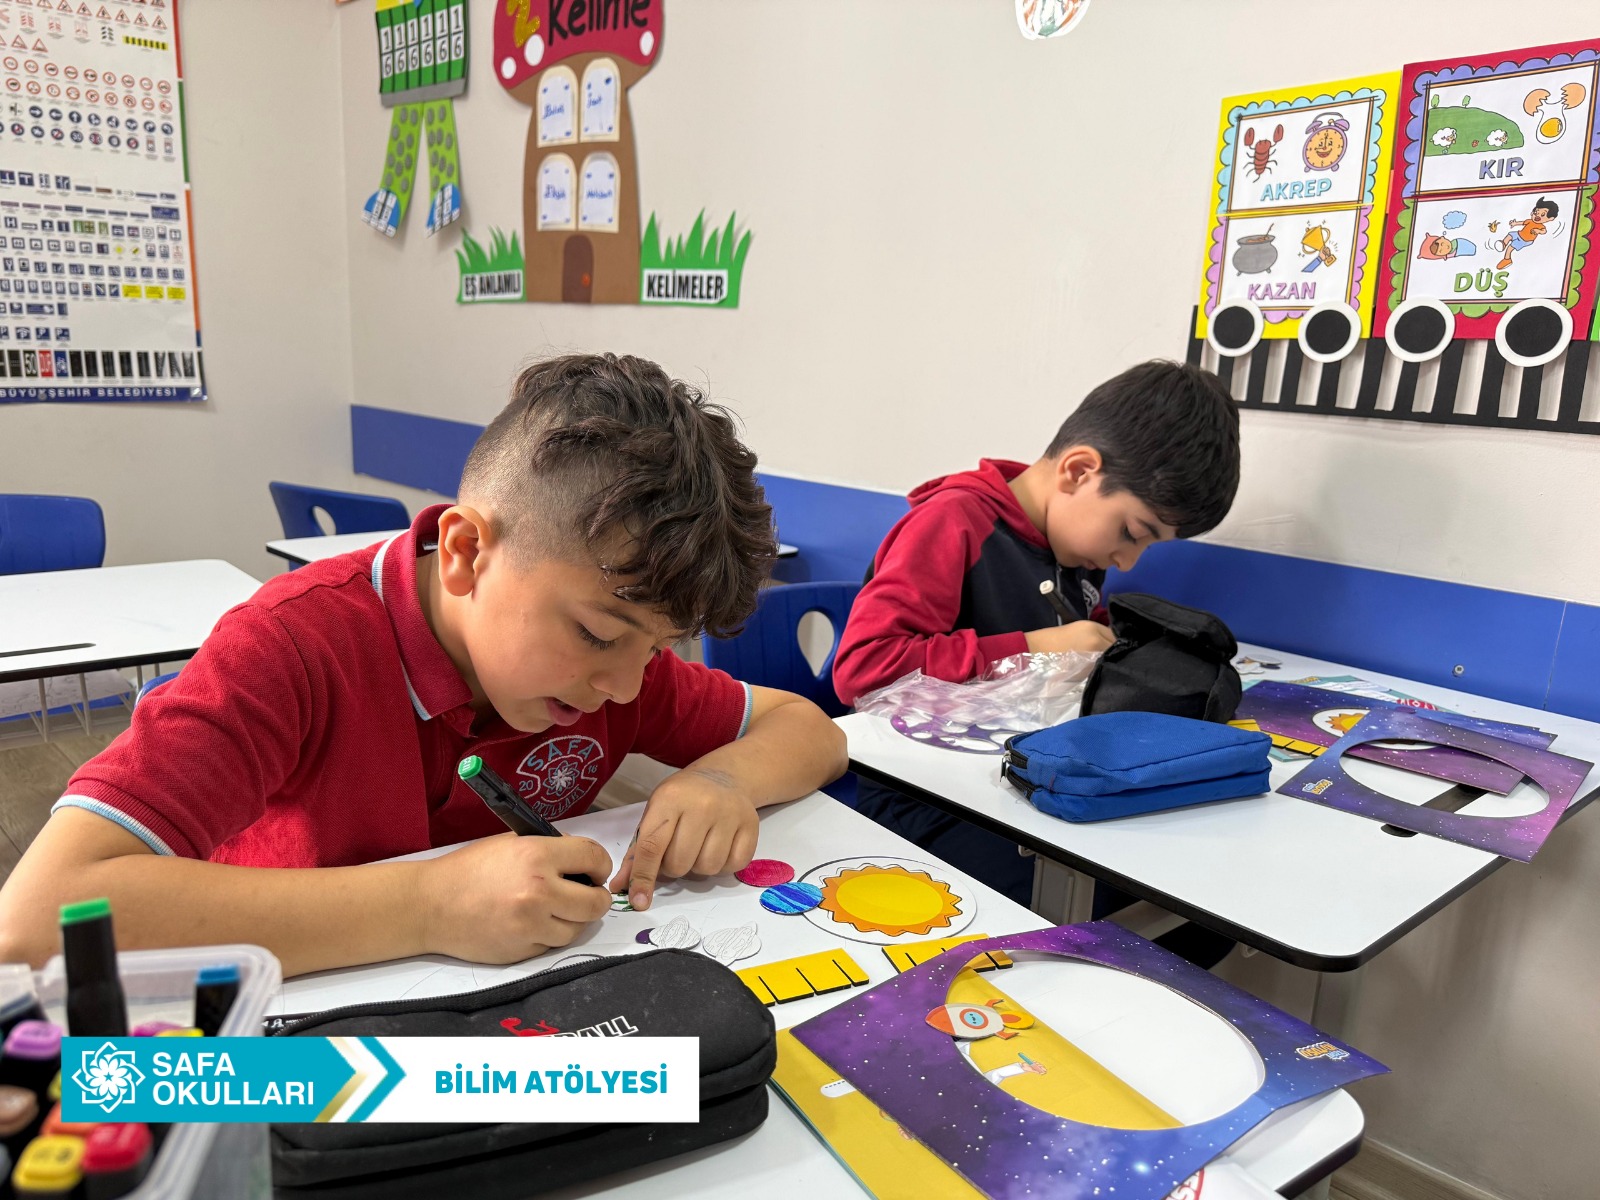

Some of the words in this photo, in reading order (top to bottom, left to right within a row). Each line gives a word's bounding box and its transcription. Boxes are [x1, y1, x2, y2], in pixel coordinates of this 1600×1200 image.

[383, 29, 390, 50] 1
[396, 25, 404, 46] 1
[410, 20, 417, 42] 1
[422, 15, 430, 37] 1
[438, 12, 445, 34] 1
[453, 6, 461, 30] 1
[384, 55, 392, 76] 6
[397, 51, 405, 72] 6
[411, 47, 418, 69] 6
[424, 42, 433, 65] 6
[439, 39, 447, 61] 6
[454, 35, 462, 58] 6
[1478, 156, 1525, 180] KIR
[1260, 177, 1332, 202] AKREP
[465, 276, 477, 300] EŞ
[479, 272, 521, 295] ANLAMLI
[647, 269, 724, 300] KELİMELER
[1246, 281, 1317, 301] KAZAN
[1453, 267, 1510, 298] DÜŞ
[97, 387, 177, 397] BELEDİYESİ
[526, 738, 596, 772] SAFA
[518, 779, 535, 793] 20
